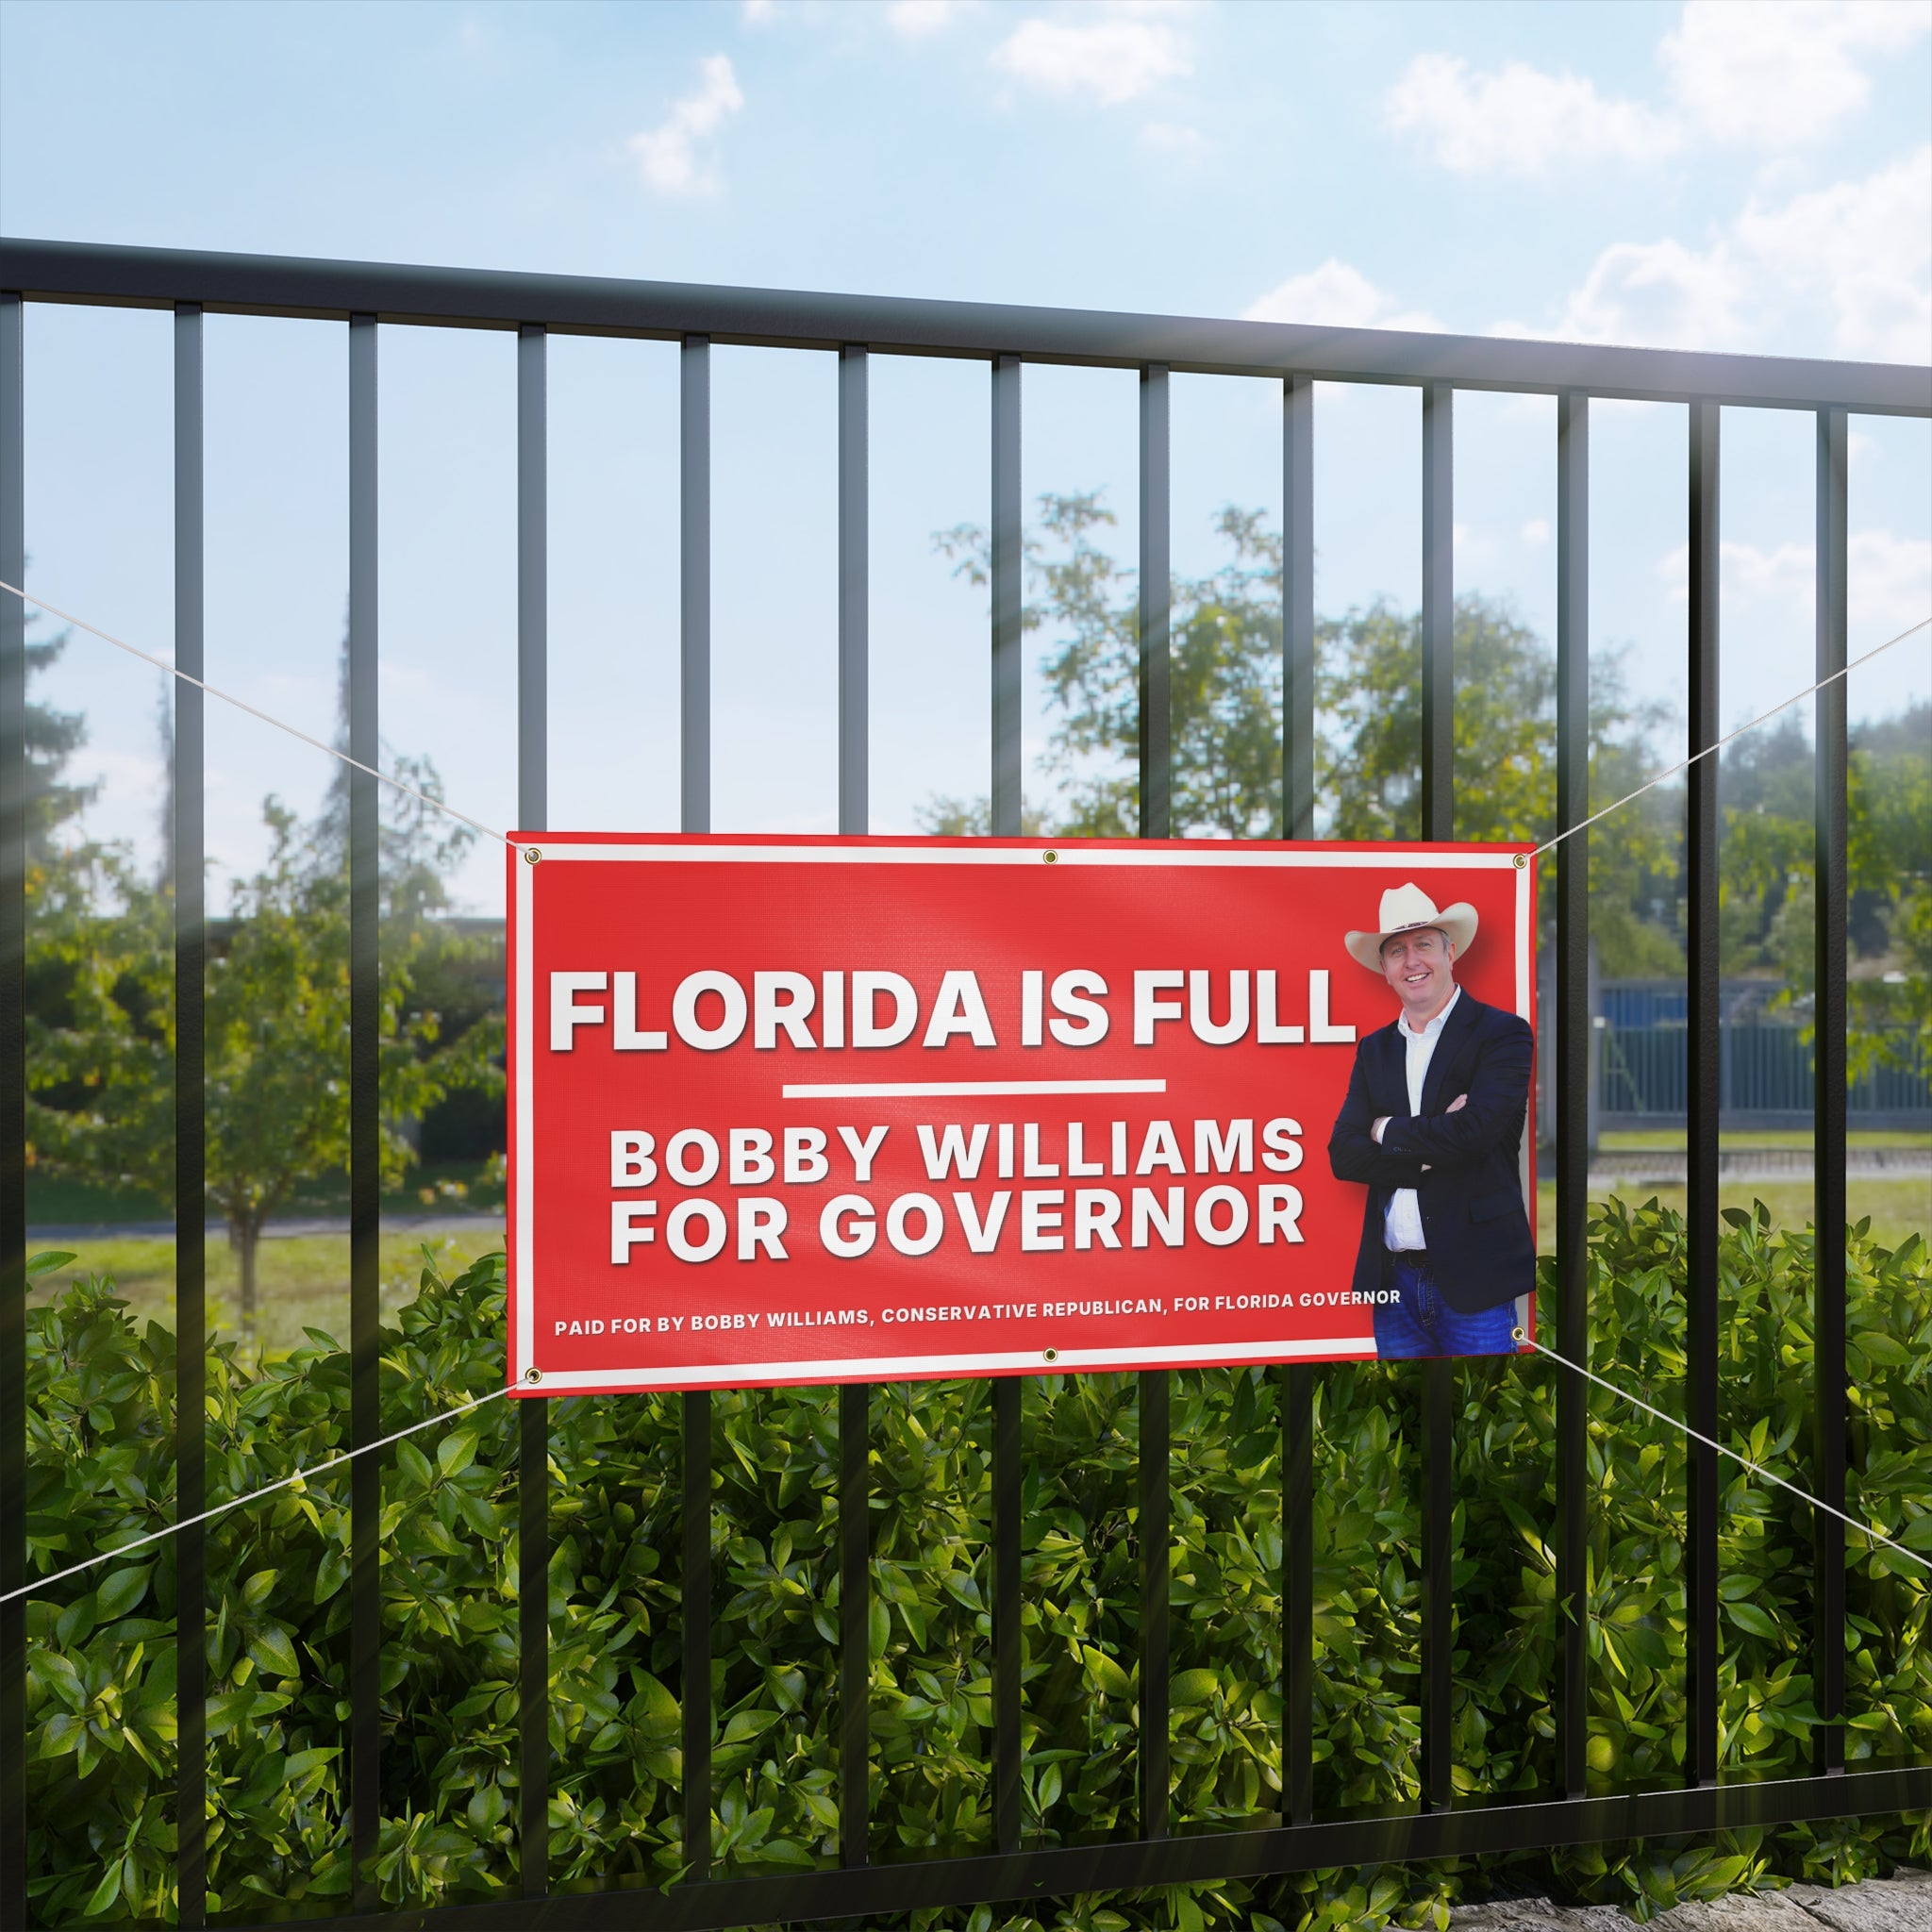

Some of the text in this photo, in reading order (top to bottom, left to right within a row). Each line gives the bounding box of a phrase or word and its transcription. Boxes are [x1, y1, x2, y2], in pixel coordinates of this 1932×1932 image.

[550, 968, 1357, 1051] FLORIDA IS FULL
[610, 1117, 1304, 1188] BOBBY WILLIAMS
[610, 1183, 1305, 1265] FOR GOVERNOR
[555, 1290, 1401, 1337] PAID FOR BY BOBBY WILLIAMS, CONSERVATIVE REPUBLICAN, FOR FLORIDA GOVERNOR
